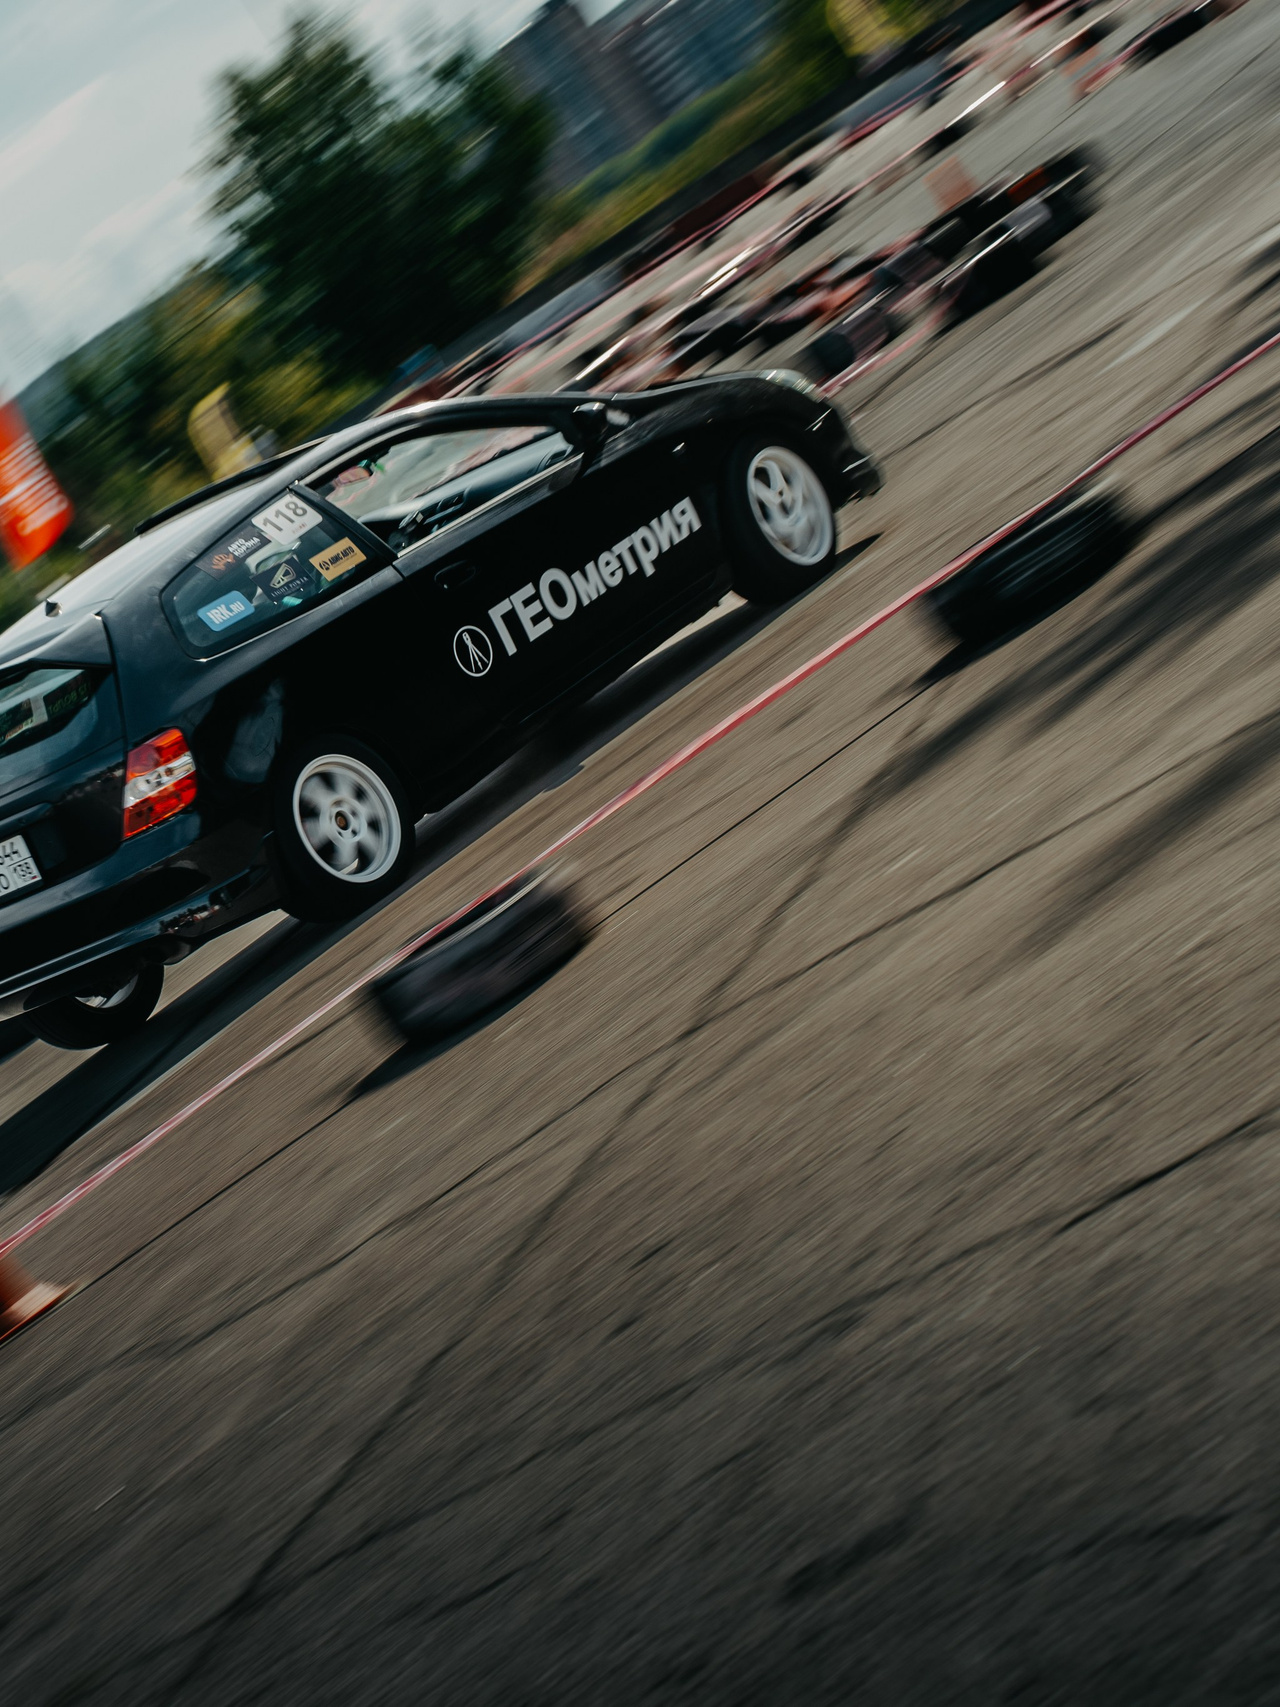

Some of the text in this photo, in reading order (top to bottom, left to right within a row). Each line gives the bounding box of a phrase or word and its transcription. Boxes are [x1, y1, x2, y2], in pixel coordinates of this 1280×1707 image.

[262, 501, 308, 532] 118
[487, 496, 702, 657] ГЕОметрия
[206, 600, 246, 624] IRK.RU
